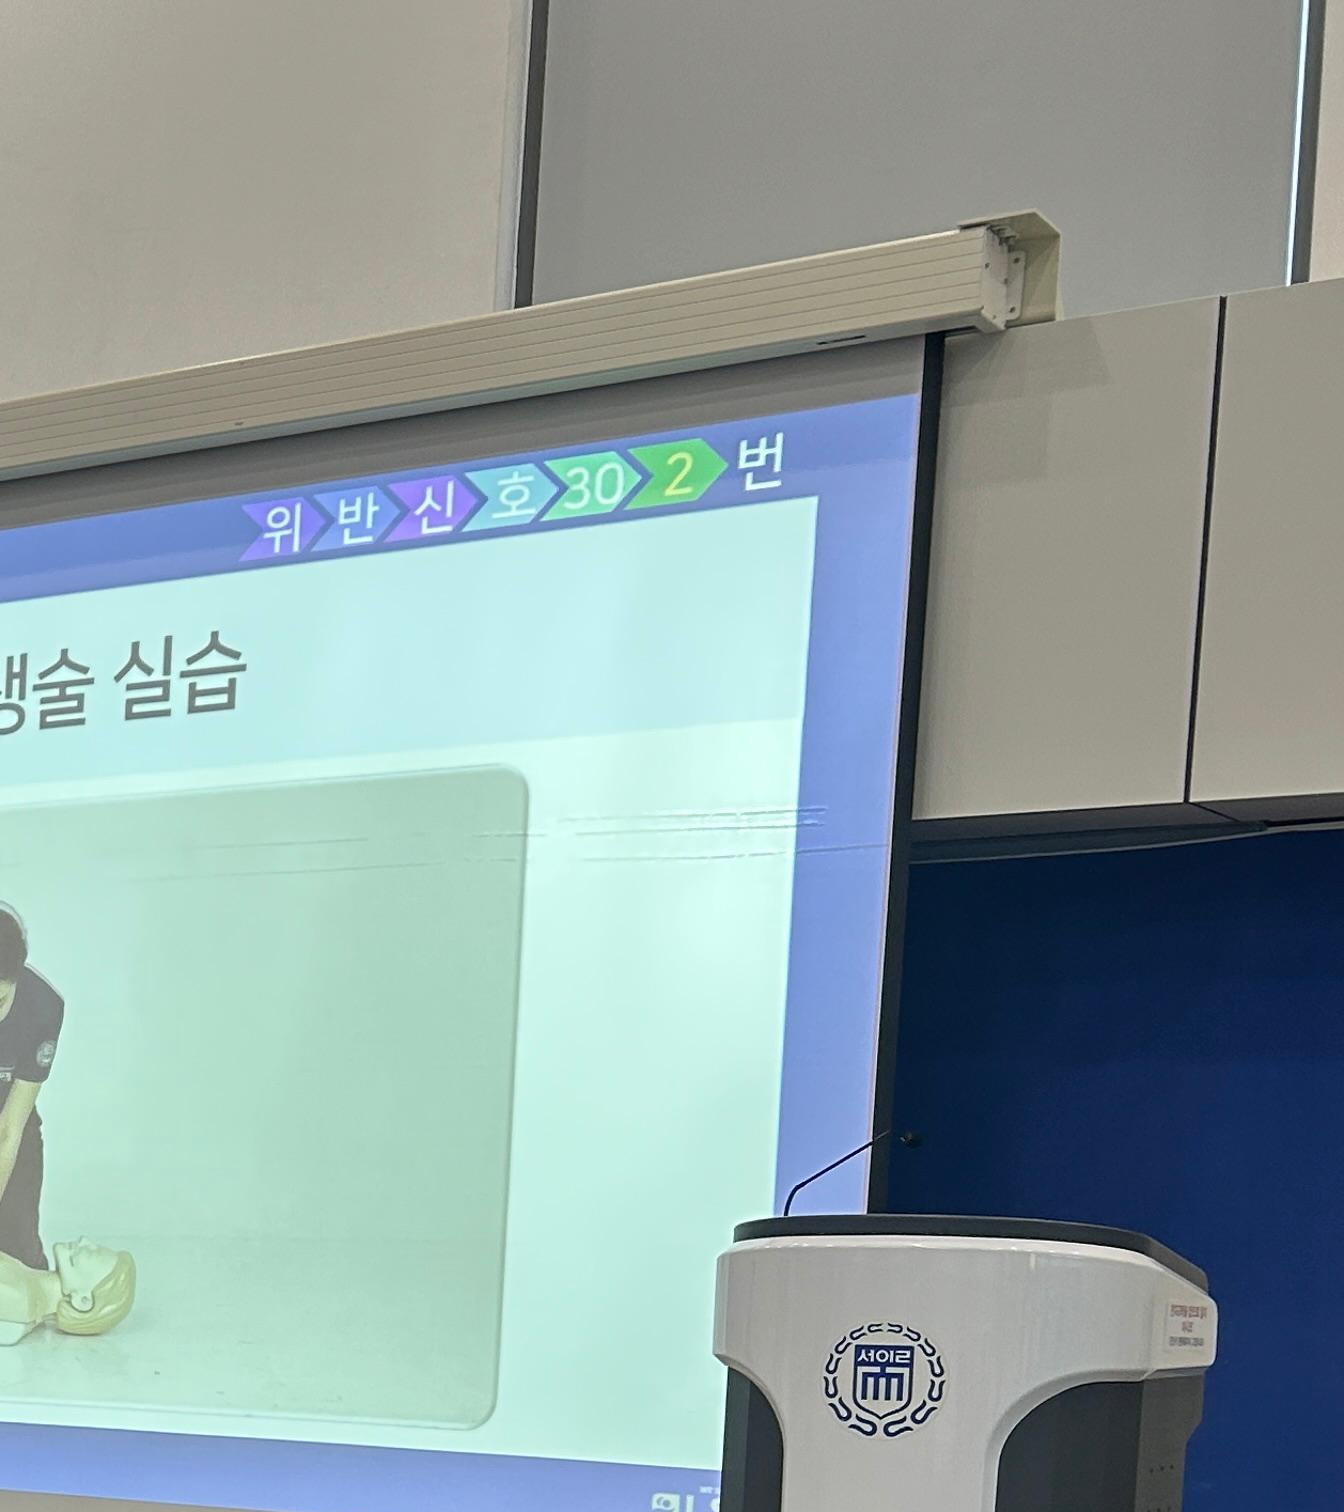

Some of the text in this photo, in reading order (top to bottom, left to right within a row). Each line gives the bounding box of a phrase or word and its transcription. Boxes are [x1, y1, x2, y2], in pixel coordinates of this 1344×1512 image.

[264, 432, 784, 554] 위 반 신 호 30 2 번
[114, 630, 247, 722] 실습
